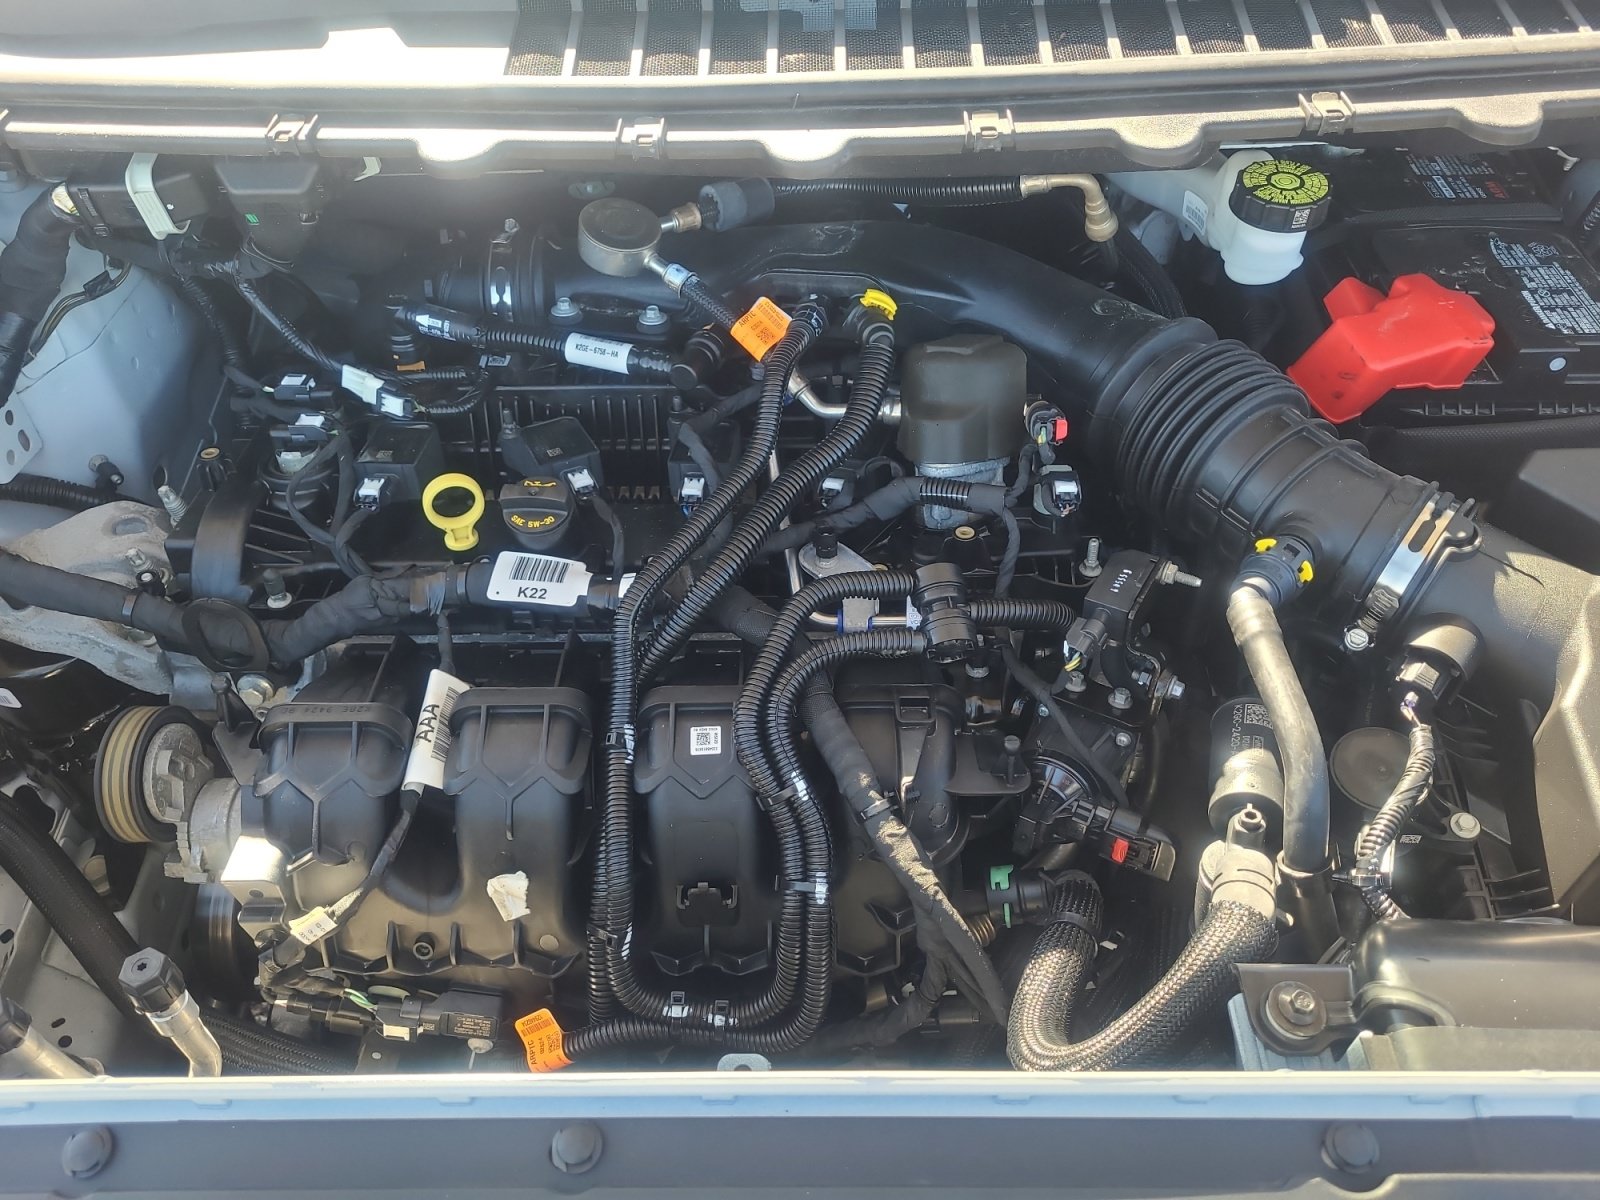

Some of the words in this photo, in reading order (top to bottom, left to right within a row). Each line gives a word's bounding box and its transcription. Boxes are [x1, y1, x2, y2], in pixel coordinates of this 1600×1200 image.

[510, 515, 526, 527] SAE
[528, 515, 555, 528] 5W-30
[517, 586, 548, 600] K22
[415, 703, 440, 743] AAA
[527, 1039, 538, 1065] ARPTC
